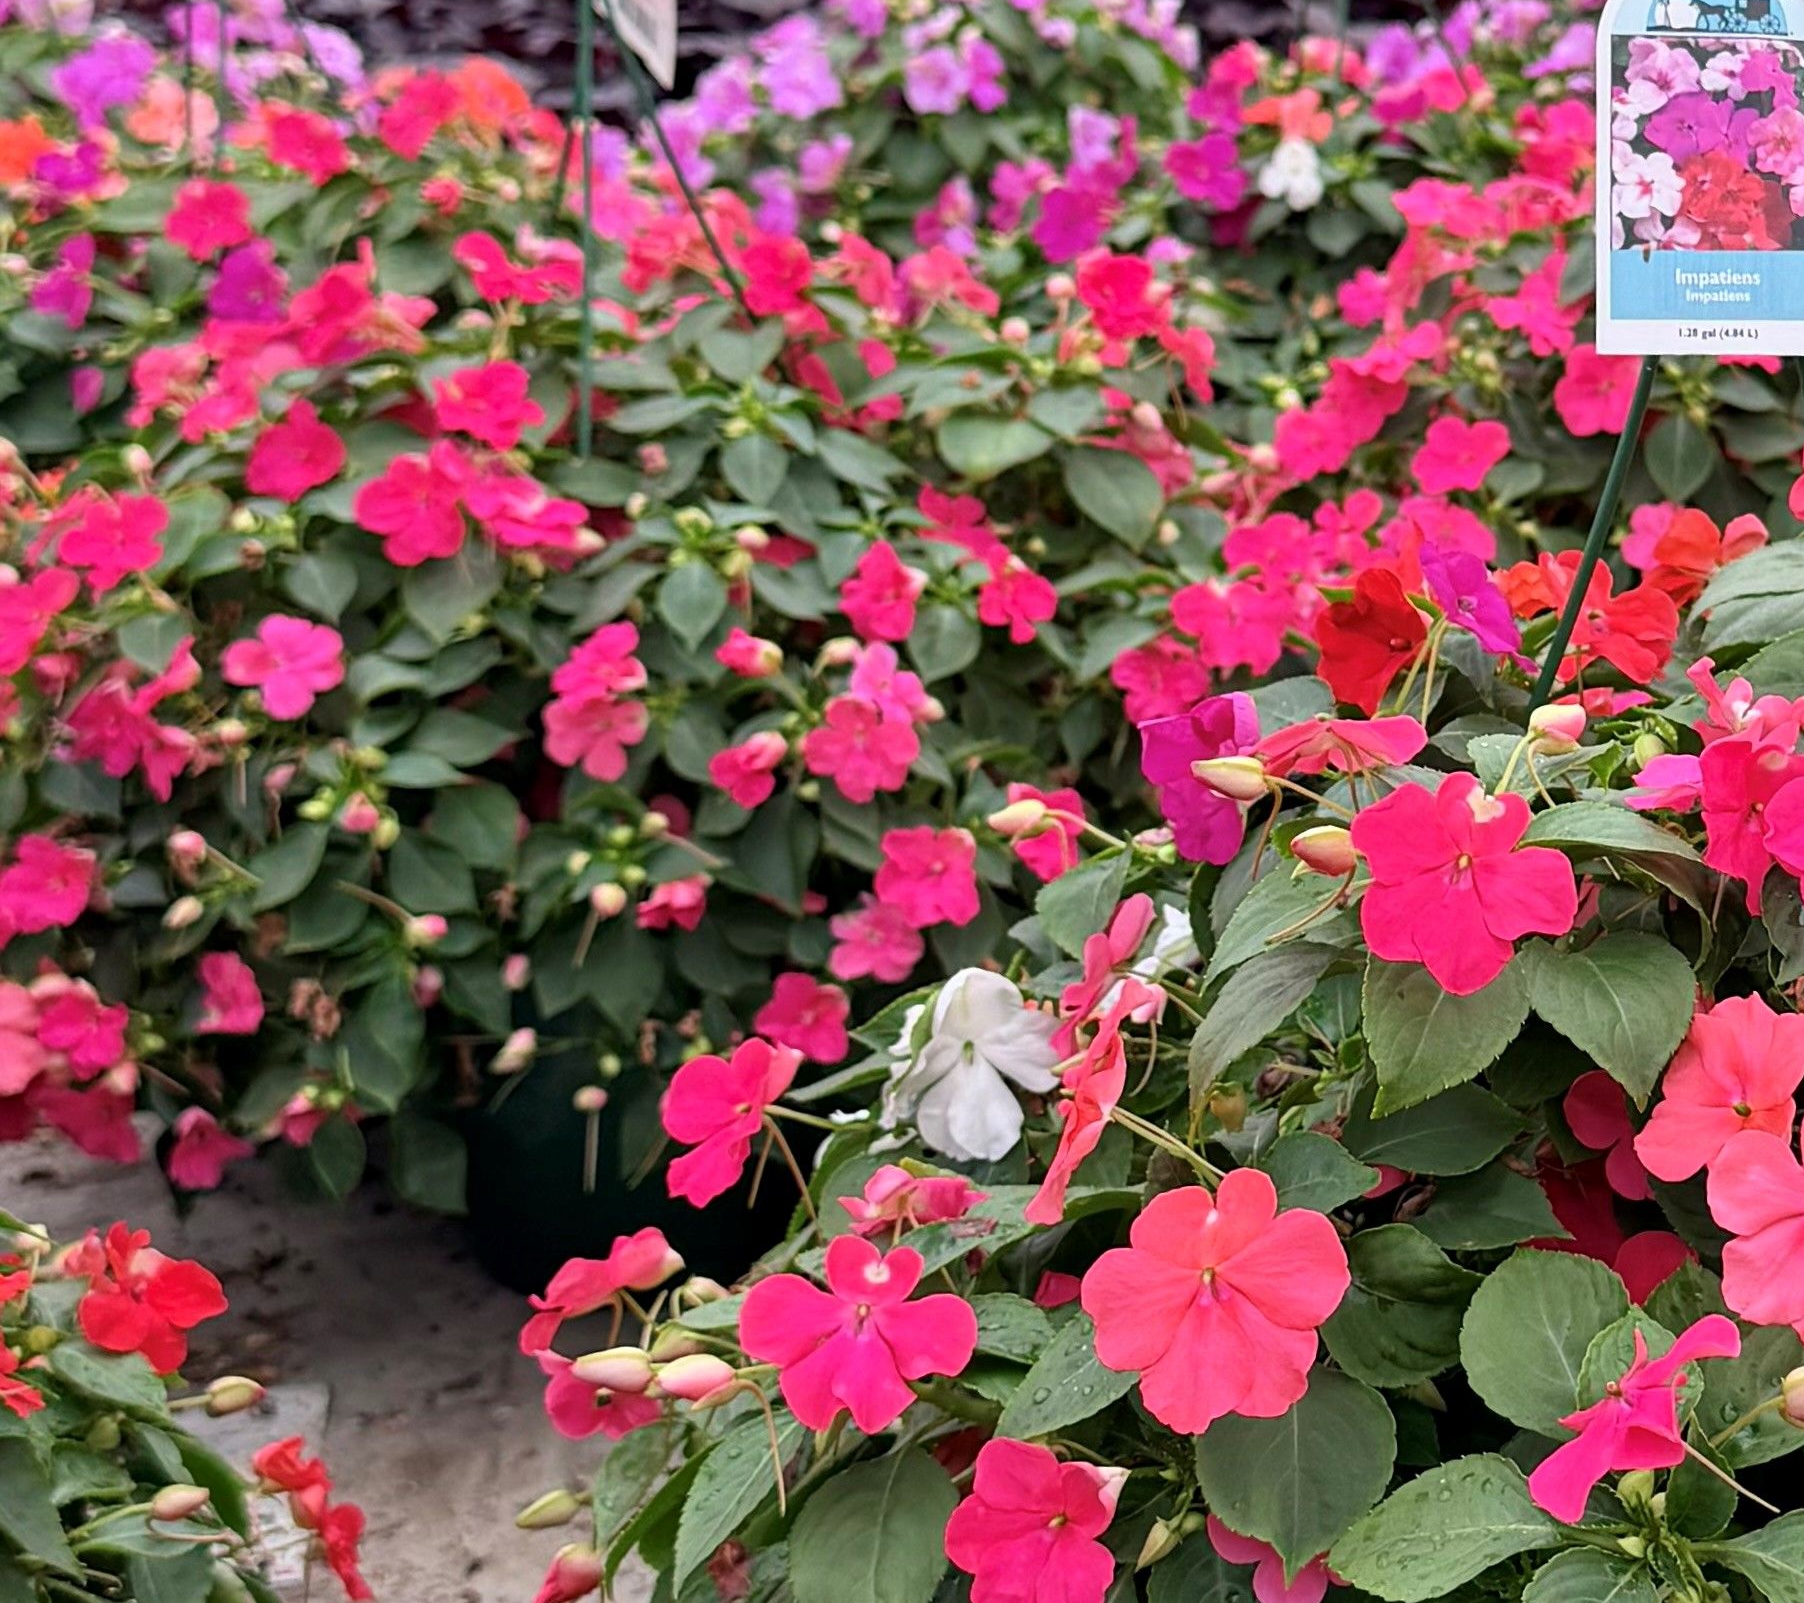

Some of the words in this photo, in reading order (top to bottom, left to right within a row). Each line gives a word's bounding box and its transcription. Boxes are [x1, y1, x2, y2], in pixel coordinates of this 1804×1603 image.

[1675, 267, 1761, 289] Impatiens
[1685, 289, 1751, 304] Impatiens
[1702, 328, 1716, 340] gal
